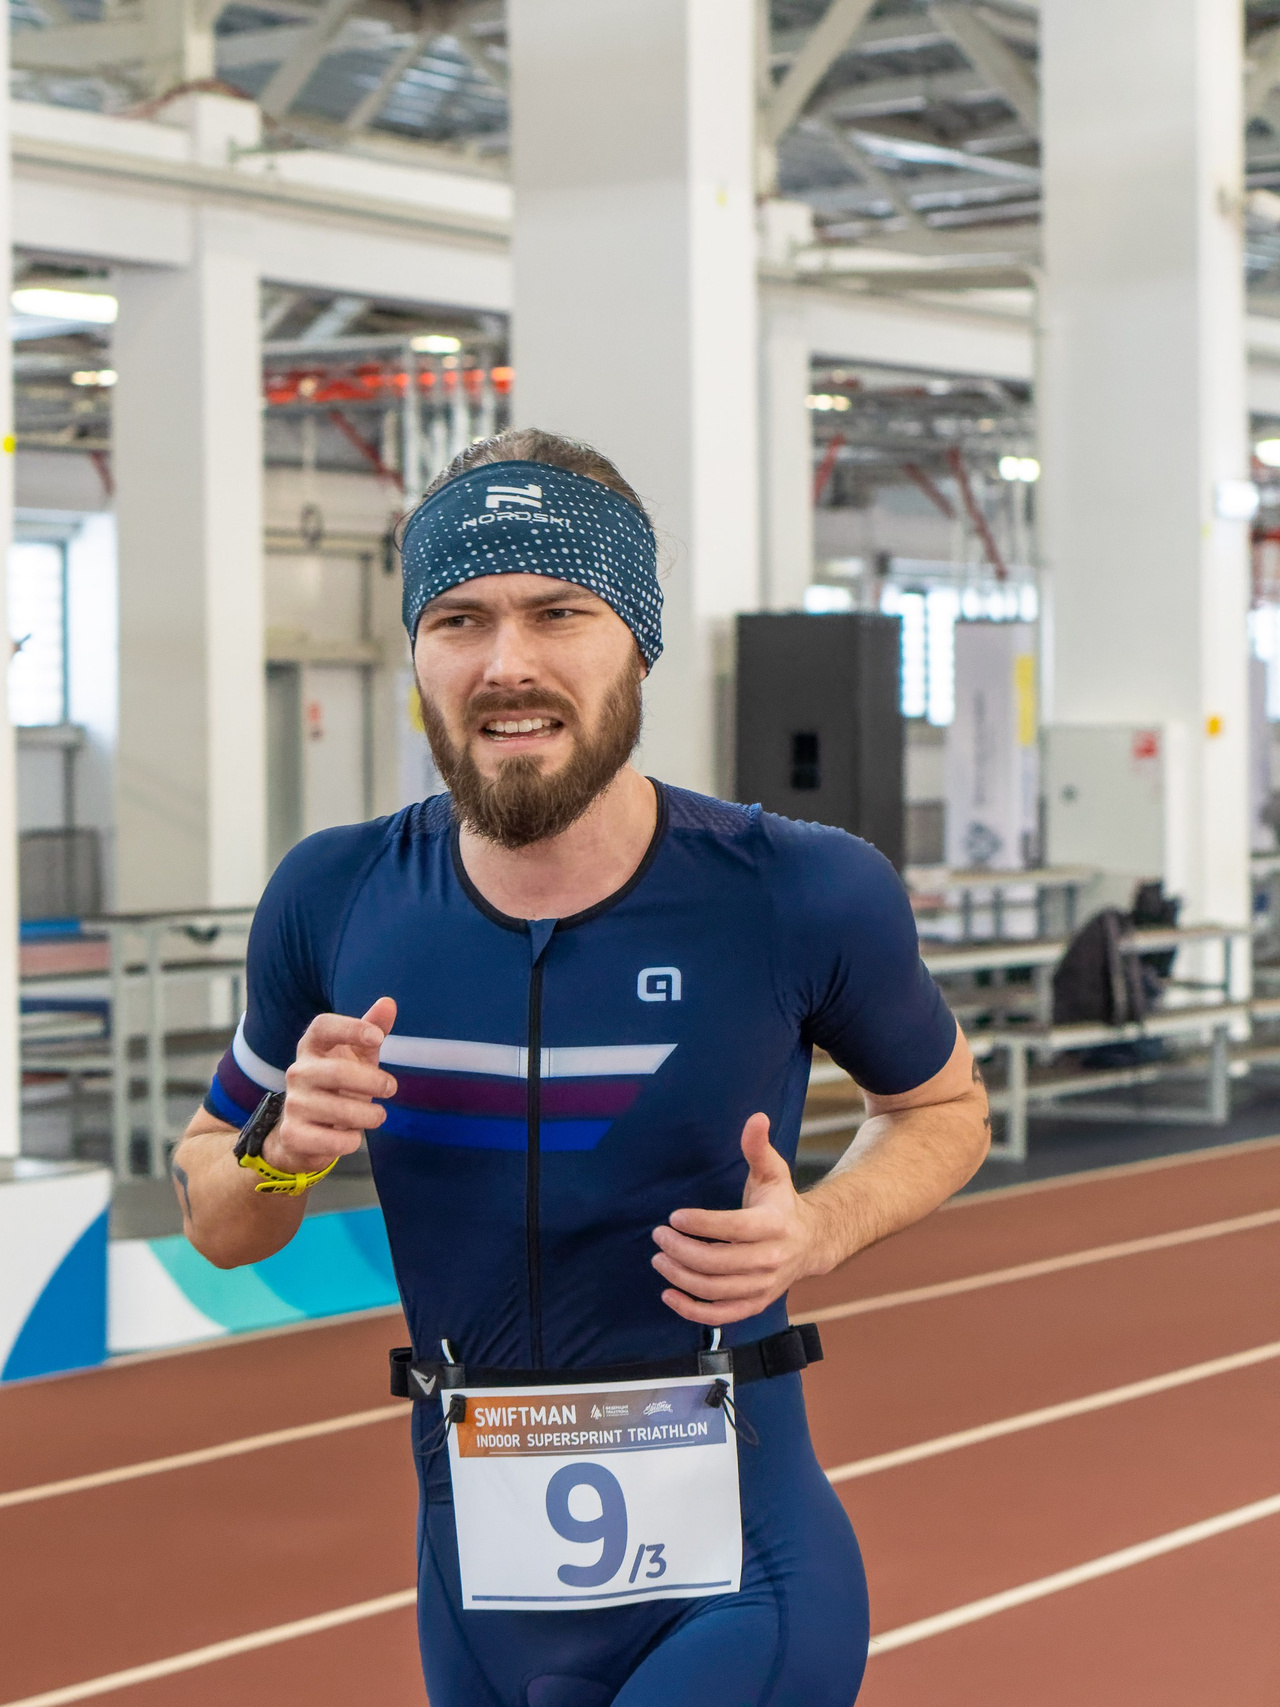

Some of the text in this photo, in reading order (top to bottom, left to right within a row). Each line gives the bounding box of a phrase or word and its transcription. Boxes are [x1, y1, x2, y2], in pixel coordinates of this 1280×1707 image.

[462, 511, 571, 529] NORDSKI
[474, 1404, 577, 1428] SWIFTMAN
[476, 1421, 708, 1448] INDOOR SUPERSPRINT TRIATHLON
